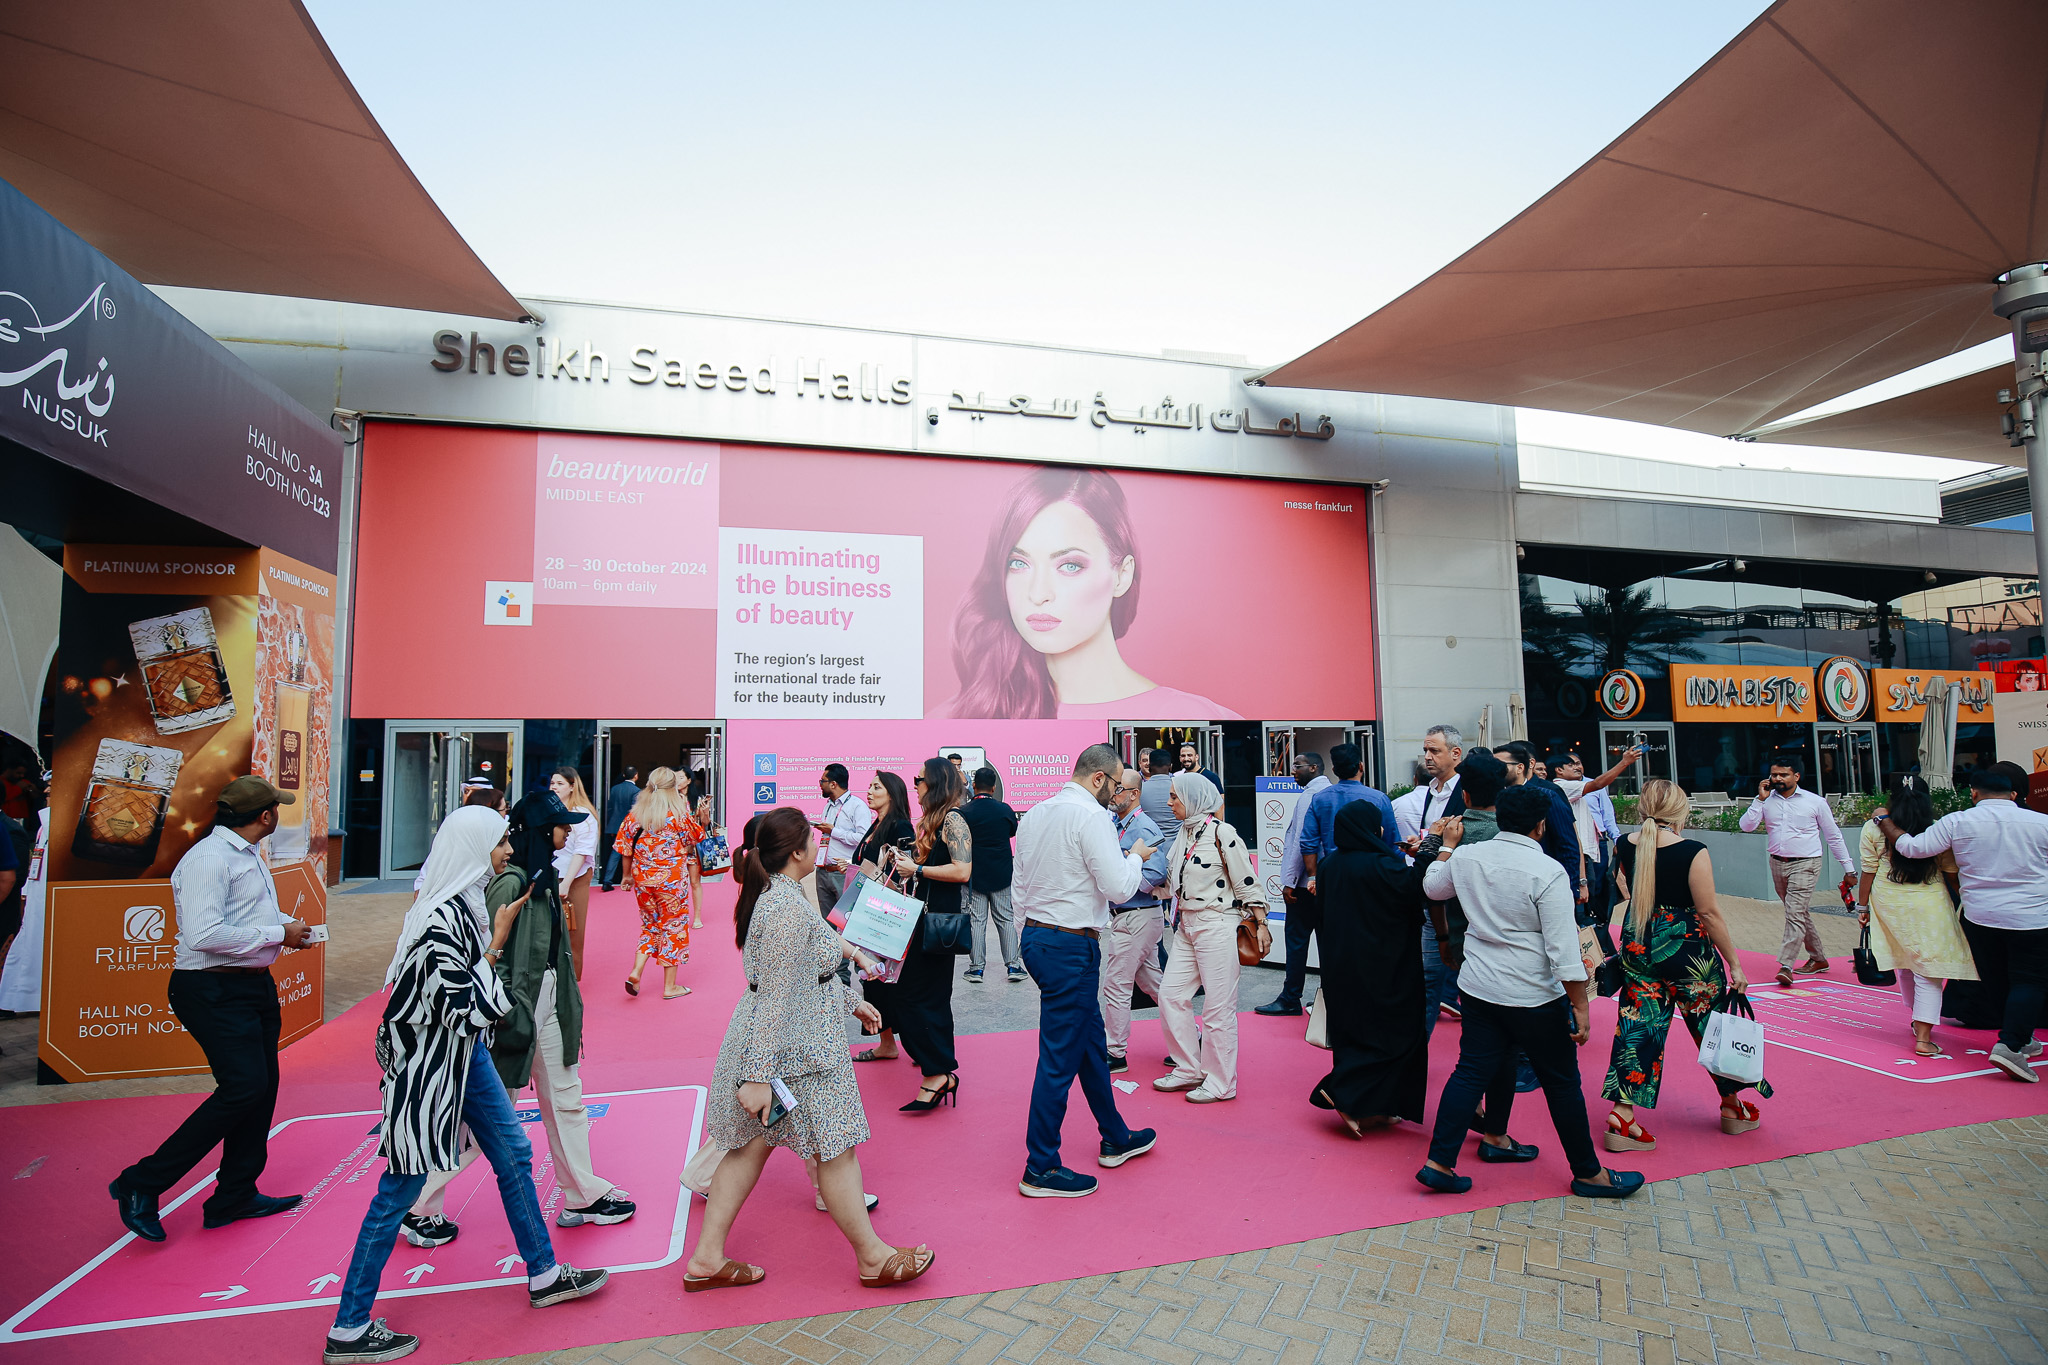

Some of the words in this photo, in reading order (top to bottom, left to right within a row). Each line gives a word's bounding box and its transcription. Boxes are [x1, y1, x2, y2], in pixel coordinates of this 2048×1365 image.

[430, 329, 610, 382] Sheikh
[628, 343, 777, 395] Saeed
[797, 356, 913, 405] Halls
[947, 389, 1082, 421] سعيد
[1090, 391, 1204, 433] الشيخ
[23, 388, 108, 447] NUSUK
[1210, 407, 1335, 440] قاعات
[248, 425, 278, 461] HALL
[282, 446, 300, 473] NO
[309, 465, 323, 488] SA
[546, 453, 709, 487] beautyworld
[247, 454, 289, 496] BOOTH
[292, 482, 331, 518] NO-L23
[546, 488, 604, 503] MIDDLE
[608, 491, 645, 504] EAST
[1284, 501, 1313, 510] messe
[1314, 501, 1353, 512] frankfurt
[84, 560, 159, 574] PLATINUM
[164, 562, 236, 575] SPONSOR
[545, 557, 565, 571] 28
[582, 558, 602, 572] 30
[606, 559, 666, 574] October
[670, 562, 708, 575] 2024
[737, 543, 880, 574] Illuminating
[269, 566, 301, 587] PLATINUM
[301, 578, 329, 598] SPONSOR
[542, 577, 577, 590] 10am
[593, 579, 622, 594] 6pm
[627, 580, 657, 595] daily
[736, 573, 776, 595] the
[785, 574, 892, 599] business
[736, 602, 761, 624] of
[770, 603, 854, 631] beauty
[734, 652, 759, 665] The
[764, 653, 816, 667] region’s
[820, 654, 865, 668] largest
[734, 671, 818, 684] international
[822, 673, 856, 685] trade
[859, 674, 881, 685] fair
[734, 691, 753, 703] for
[757, 692, 779, 703] the
[783, 692, 828, 706] beauty
[832, 692, 886, 706] industry
[1685, 676, 1740, 708] INDIA
[1741, 676, 1810, 718] BISTRO
[2018, 721, 2047, 729] SWISS
[1009, 755, 1070, 764] DOWNLOAD
[1009, 766, 1030, 776] THE
[1032, 766, 1071, 776] MOBILE
[1267, 782, 1304, 790] ATTENT
[280, 977, 291, 992] NO
[296, 971, 305, 984] SA
[79, 1005, 120, 1020] HALL
[125, 1003, 152, 1017] NO
[79, 1022, 138, 1038] BOOTH
[341, 1136, 378, 1161] Marketing
[328, 1161, 352, 1176] Suite
